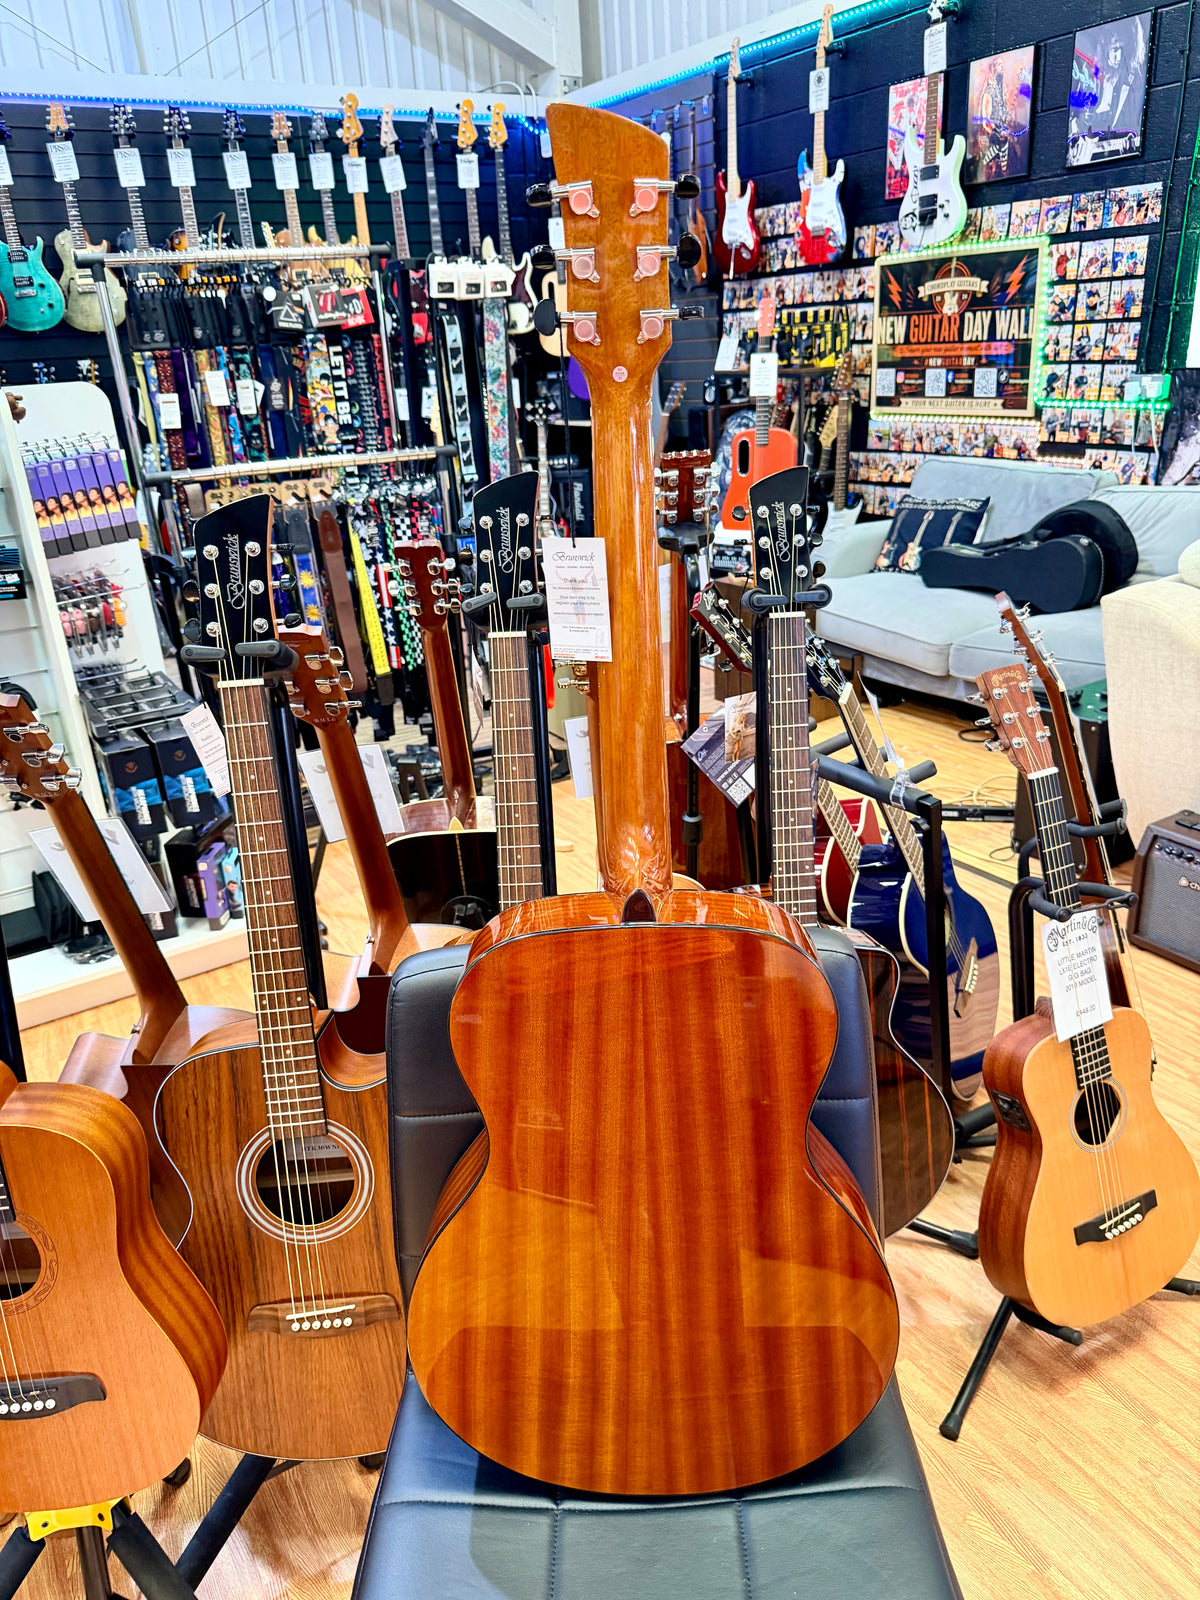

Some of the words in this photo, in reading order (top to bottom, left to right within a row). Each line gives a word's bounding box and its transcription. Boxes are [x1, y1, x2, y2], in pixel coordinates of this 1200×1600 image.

[878, 316, 907, 345] NEW
[909, 314, 960, 344] GUITAR
[963, 310, 992, 342] DAY
[328, 345, 346, 379] LET
[334, 380, 348, 400] IT
[336, 401, 352, 425] BE
[496, 506, 514, 574] Brunswick
[772, 501, 790, 562] Brunswick
[552, 552, 596, 562] Brunswick
[222, 533, 245, 610] Brunswick
[1057, 954, 1075, 966] LITTLE
[1076, 946, 1097, 960] MARTIN
[1073, 954, 1098, 970] ELECTRO
[1068, 972, 1080, 981] GG
[1080, 967, 1092, 976] BAG
[1078, 975, 1097, 987] MODEL
